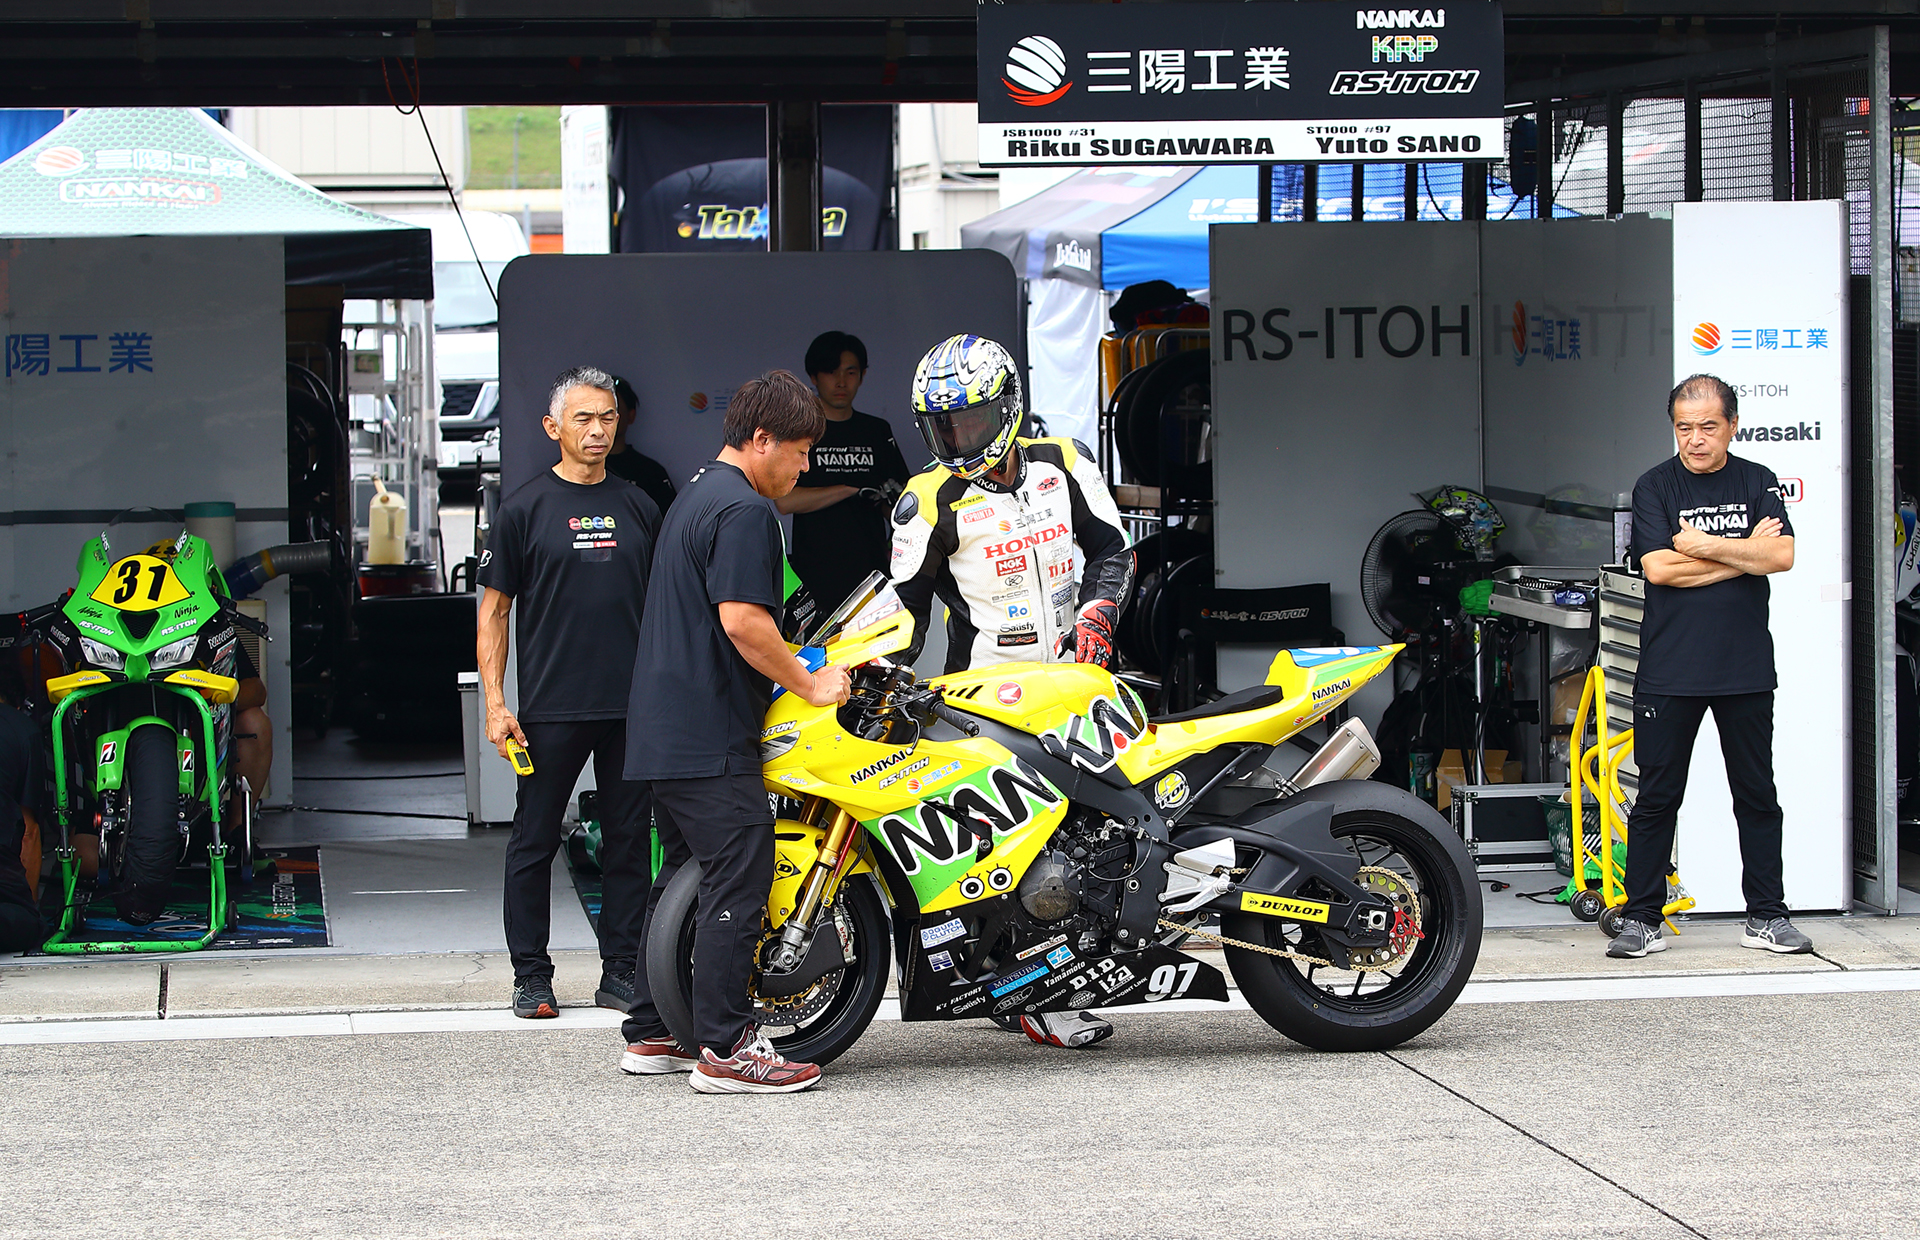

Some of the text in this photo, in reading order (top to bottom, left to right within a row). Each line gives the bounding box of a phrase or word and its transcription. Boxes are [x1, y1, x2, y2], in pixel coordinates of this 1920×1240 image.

[1372, 35, 1439, 63] KRP
[1087, 47, 1290, 94] 三陽工業
[1329, 70, 1480, 95] RS-ITOH
[1002, 127, 1096, 137] JSB1000 #31
[1307, 125, 1391, 134] ST1000 #97
[1007, 137, 1275, 157] Riku SUGAWARA
[1316, 135, 1481, 154] Yuto SANO
[95, 148, 248, 179] 三陽工業
[75, 181, 206, 200] NANKAI
[1223, 305, 1470, 361] RS-ITOH
[1731, 328, 1828, 350] 三陽工業
[4, 332, 153, 377] 陽工業
[1731, 421, 1821, 442] wasaki
[817, 454, 874, 466] NANKAI
[964, 509, 994, 522] SPRINTA
[983, 523, 1069, 559] HONDA
[998, 557, 1024, 571] NGK
[113, 560, 167, 604] 31
[174, 603, 200, 619] Ninja
[1259, 607, 1309, 621] RS-ITOH
[78, 620, 115, 636] RS-ITOH
[161, 618, 197, 636] RS-ITOH
[1000, 622, 1035, 633] Satisfy
[1312, 678, 1351, 701] NANKAI
[761, 720, 797, 738] S-ITOH
[850, 749, 906, 785] NANKAI
[879, 756, 930, 790] RS-ITOH
[1260, 900, 1323, 916] DUNLOP
[928, 919, 960, 935] OGURA
[930, 925, 963, 940] CLUTCH
[993, 964, 1039, 989] MATSUBA
[995, 968, 1047, 997] CONCRETE
[1044, 961, 1086, 988] Yamamoto
[1069, 958, 1116, 990] D.I.D
[1144, 961, 1200, 1001] 97
[950, 986, 983, 1005] FACTORY
[1036, 988, 1067, 1006] brembo
[1116, 986, 1134, 998] POINT
[1134, 977, 1148, 988] LINK
[952, 996, 986, 1015] Satisfy
